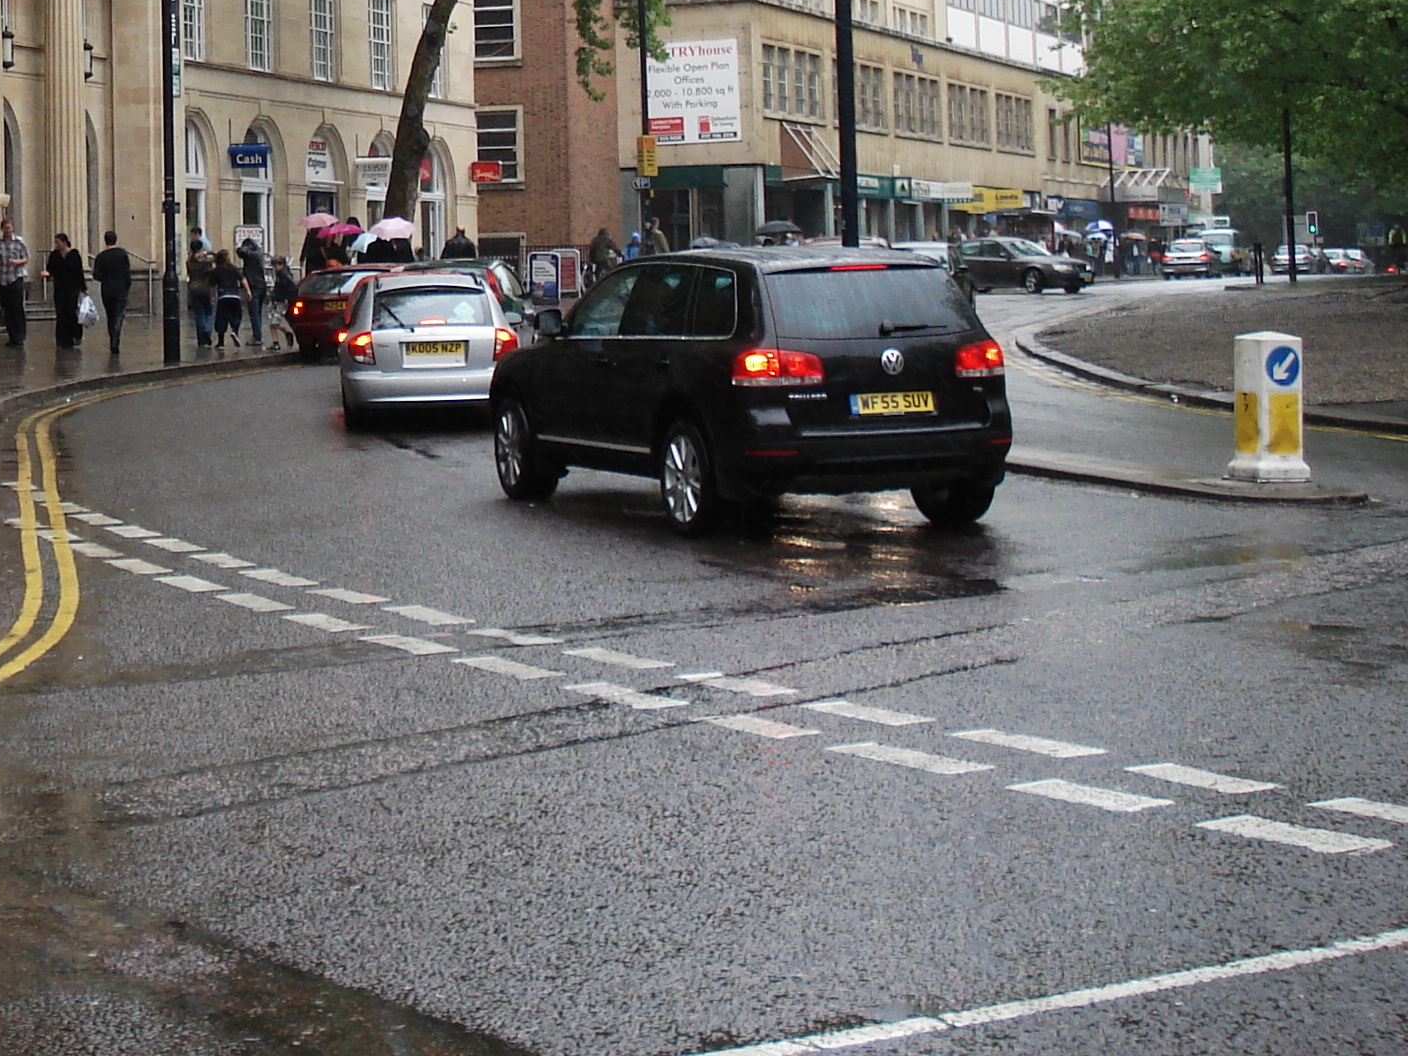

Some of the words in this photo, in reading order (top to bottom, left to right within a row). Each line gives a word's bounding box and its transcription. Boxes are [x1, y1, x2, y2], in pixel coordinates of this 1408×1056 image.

[648, 65, 681, 74] Flexible
[683, 63, 709, 73] Open
[711, 62, 730, 71] Plan
[673, 75, 705, 85] Offices
[715, 88, 725, 96] sq
[662, 100, 683, 109] With
[685, 99, 718, 109] Parking
[235, 153, 263, 165] Cash
[441, 343, 462, 354] NZP
[860, 394, 899, 410] WF55
[903, 393, 930, 409] SUV
